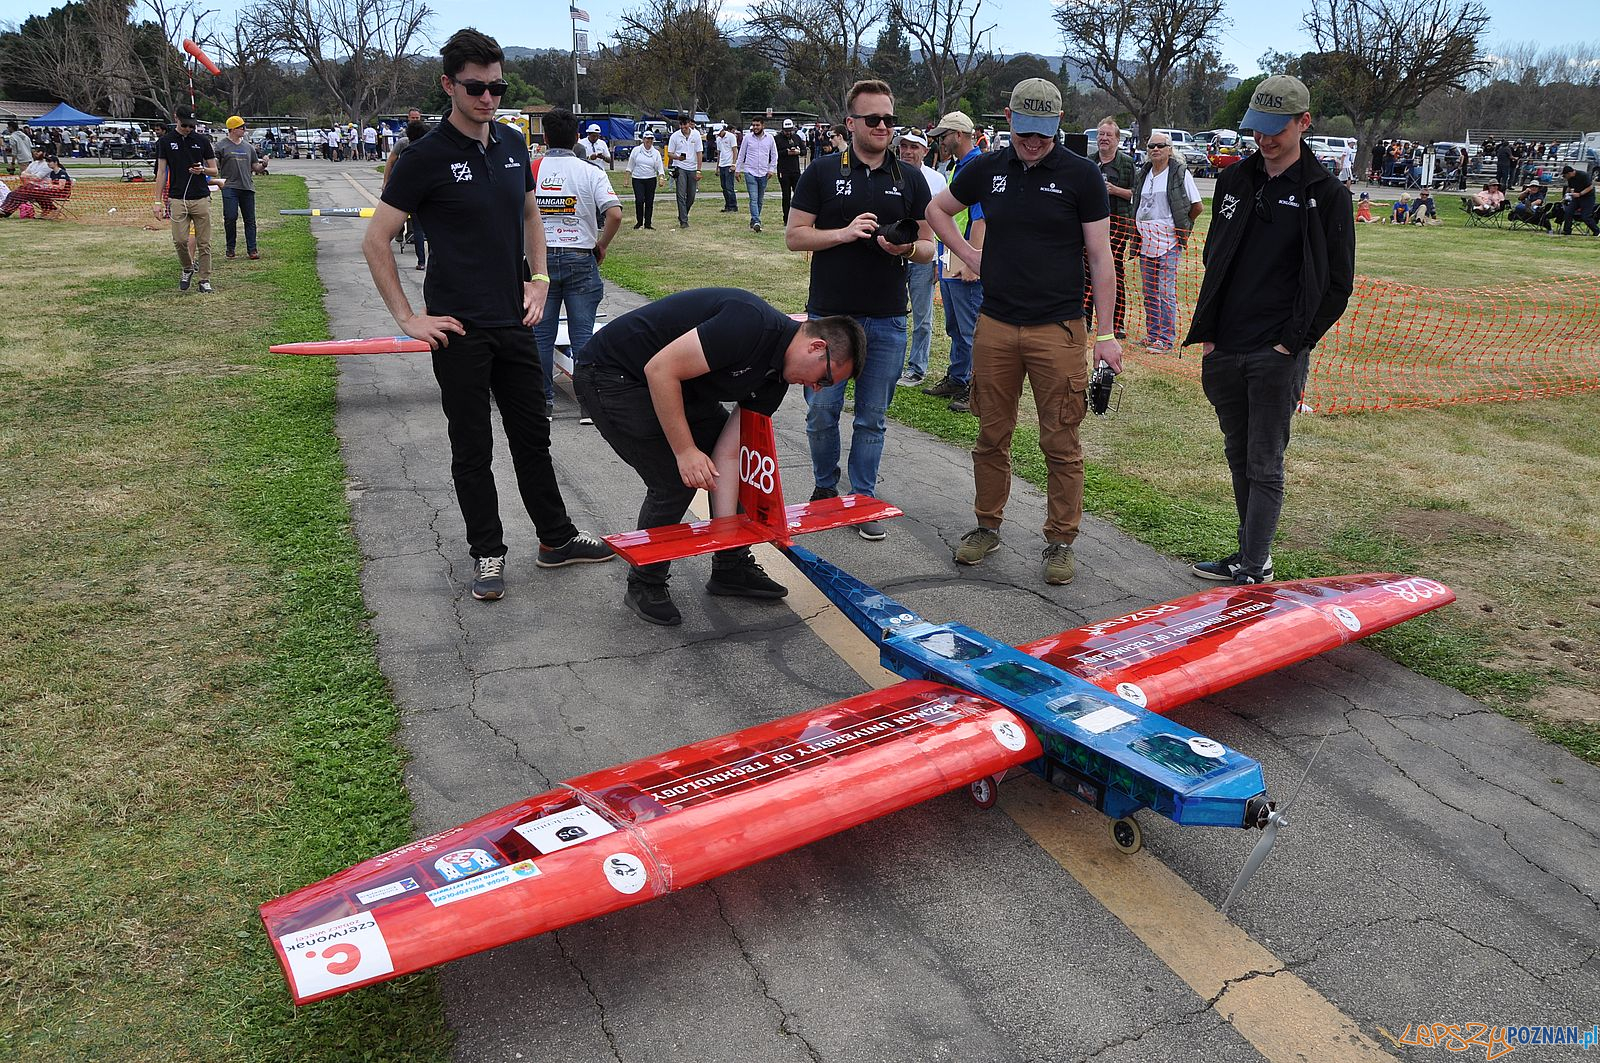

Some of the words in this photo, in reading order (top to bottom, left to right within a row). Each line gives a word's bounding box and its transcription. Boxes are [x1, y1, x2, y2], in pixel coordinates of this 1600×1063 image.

[1023, 98, 1052, 112] SUAS
[1255, 93, 1283, 108] SUAS
[739, 446, 775, 494] 028
[1382, 578, 1446, 603] 028
[1228, 602, 1270, 618] POZNAN
[1157, 633, 1170, 643] OF
[1168, 614, 1230, 638] UNIVERSITY
[1079, 639, 1156, 665] TECHNOLOGY
[893, 701, 953, 726] POZNAN
[797, 718, 896, 756] UNIVERSITY
[772, 752, 795, 764] OF
[654, 763, 770, 802] TECHNOLOGY
[559, 827, 582, 839] DS
[285, 921, 375, 952] czerwonak
[328, 920, 359, 932] zobacz
